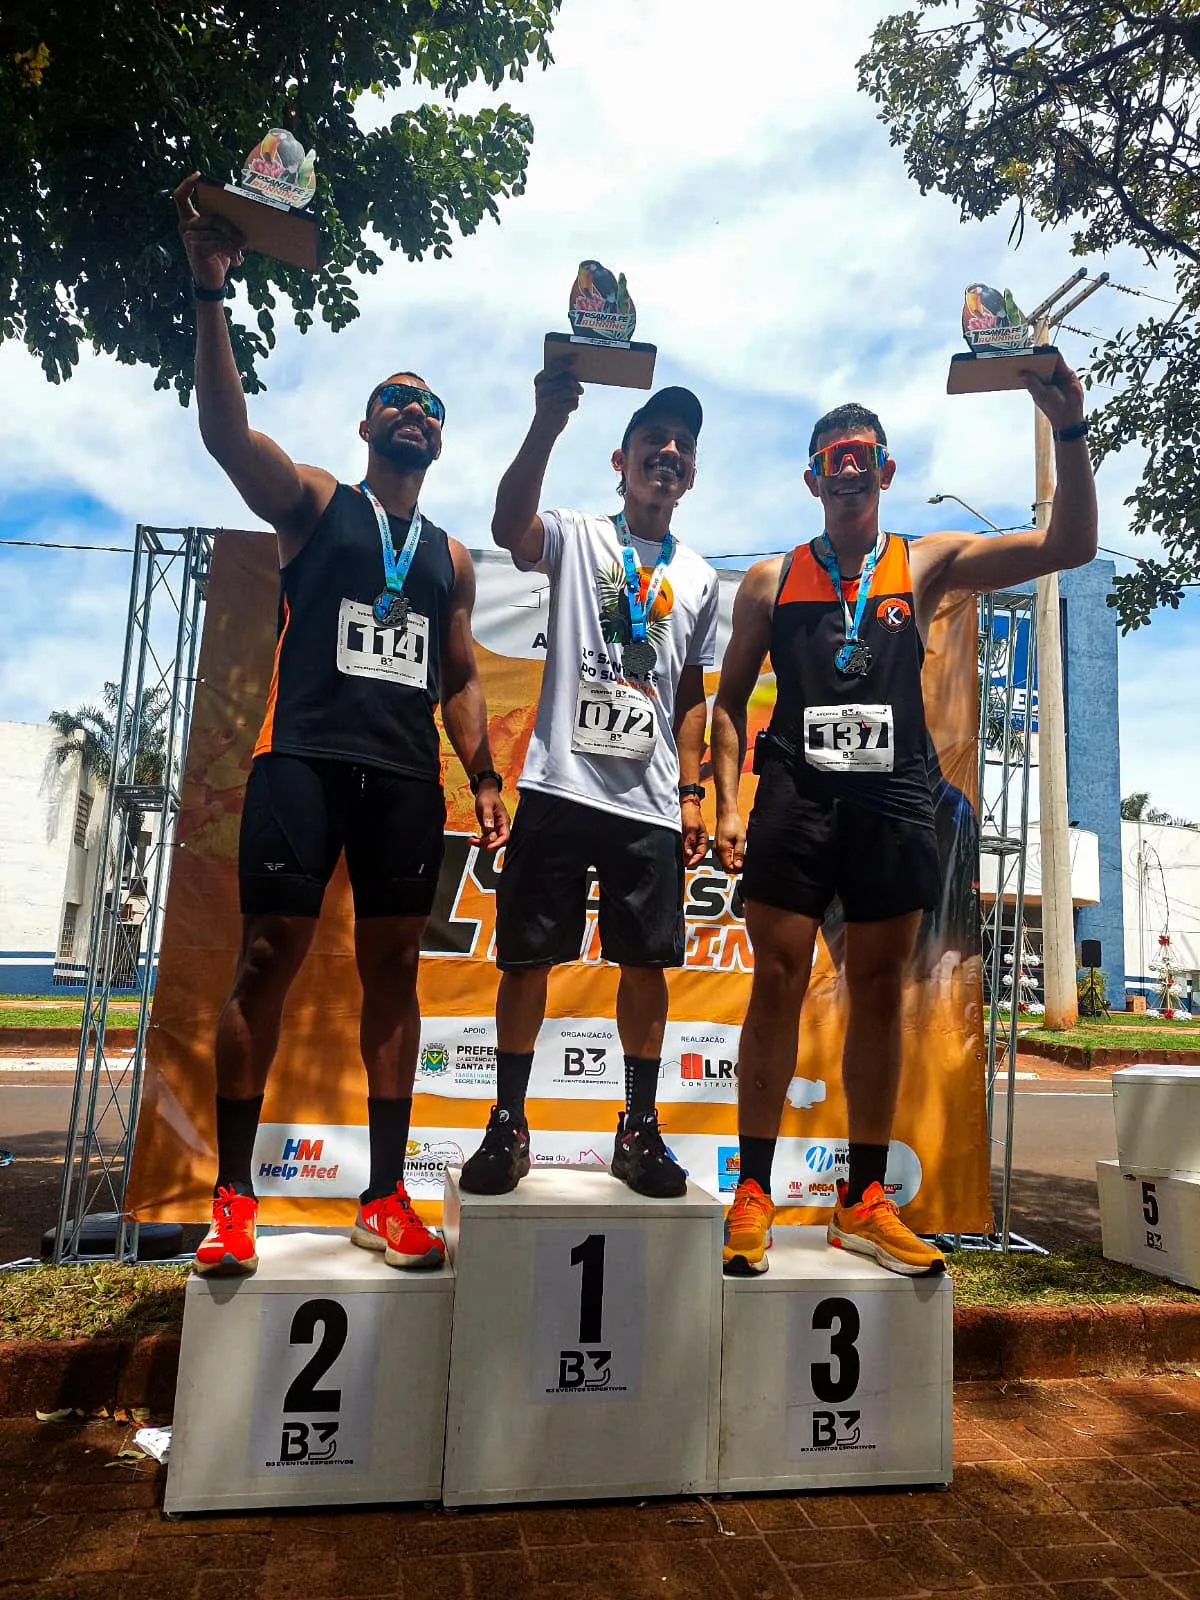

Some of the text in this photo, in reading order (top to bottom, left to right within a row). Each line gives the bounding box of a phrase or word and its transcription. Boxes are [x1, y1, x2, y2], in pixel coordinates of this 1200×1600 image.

[252, 180, 301, 201] RUNNING
[262, 176, 292, 193] SANTA
[582, 320, 625, 330] RUNNING
[590, 313, 617, 321] SANTA
[979, 334, 1020, 344] RUNNING
[887, 606, 902, 625] K
[356, 626, 418, 662] 114
[584, 702, 652, 739] 072
[816, 722, 882, 750] 137
[455, 1062, 484, 1070] SANTA
[564, 1047, 607, 1076] B3
[282, 1138, 325, 1161] HM
[535, 1153, 566, 1162] Casa da
[259, 1163, 339, 1180] Help Med
[808, 1183, 835, 1192] MEGA
[1141, 1181, 1160, 1227] 5
[1146, 1231, 1163, 1250] B3
[570, 1234, 606, 1344] 1
[283, 1298, 348, 1413] 2
[811, 1296, 861, 1404] 3
[558, 1350, 612, 1388] B3
[812, 1410, 861, 1447] B3
[280, 1422, 339, 1461] B3
